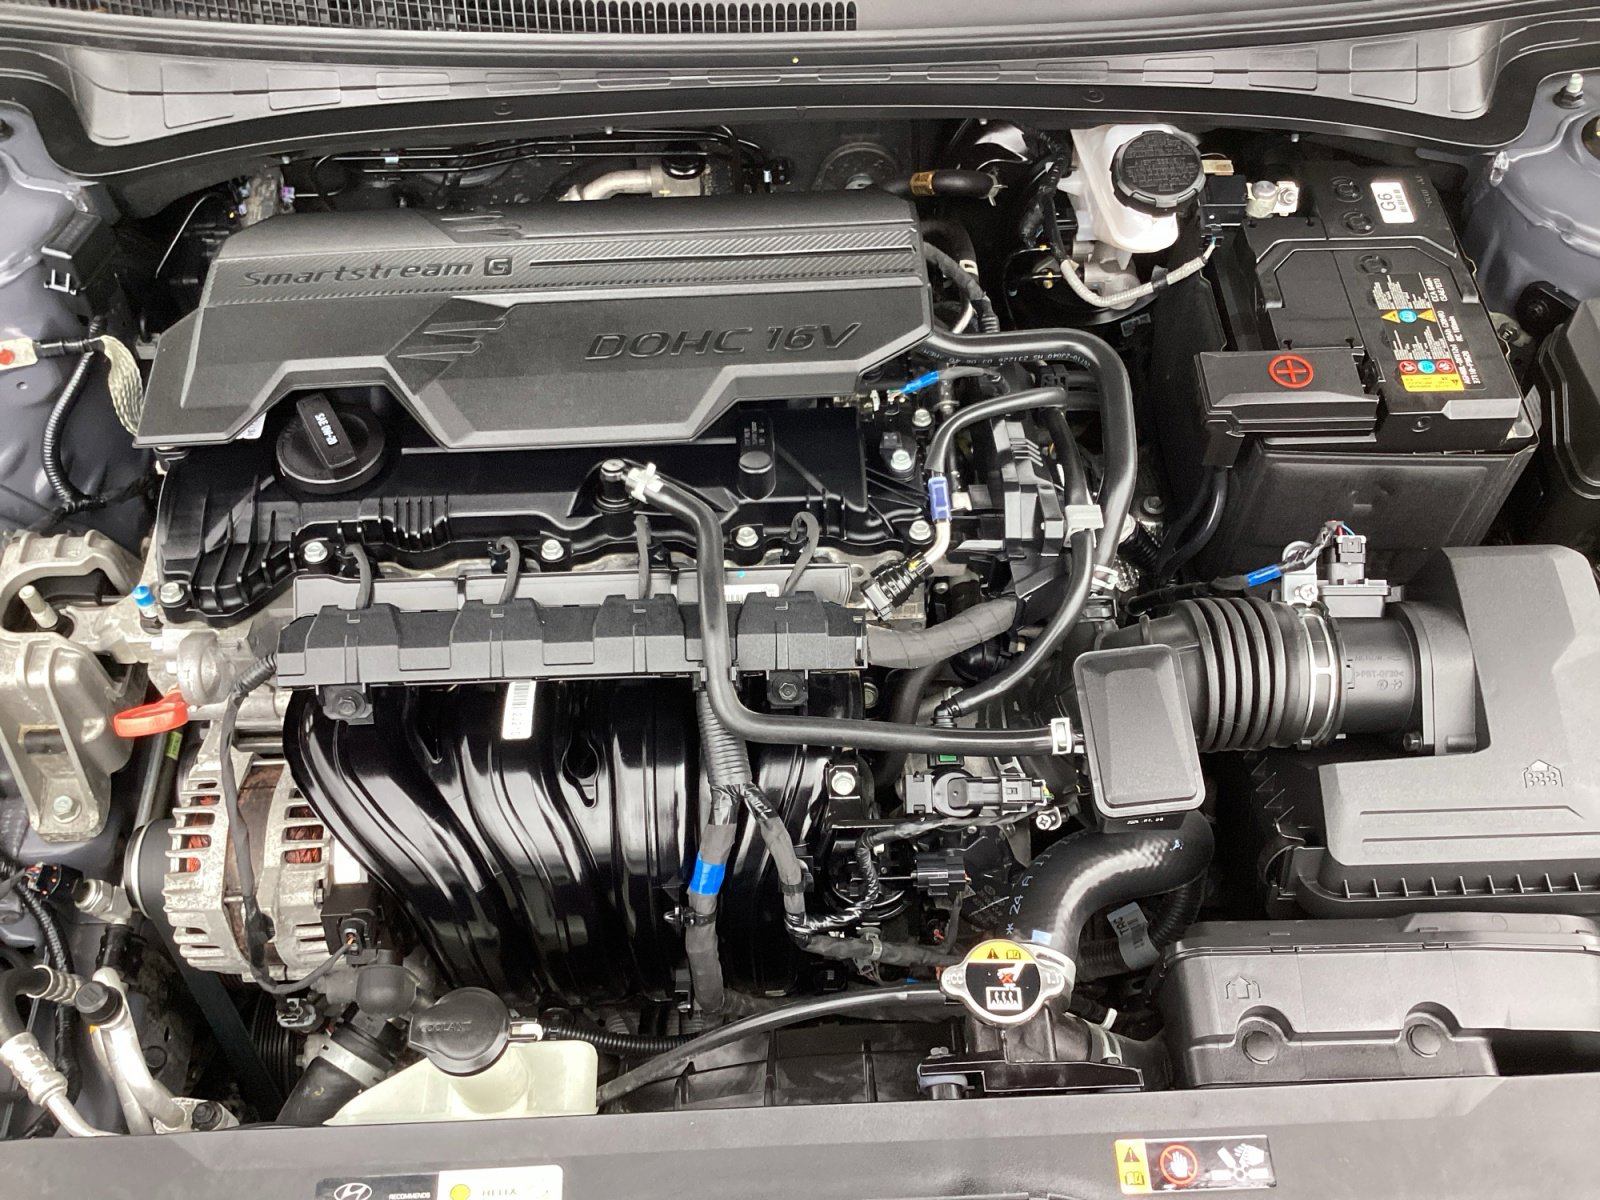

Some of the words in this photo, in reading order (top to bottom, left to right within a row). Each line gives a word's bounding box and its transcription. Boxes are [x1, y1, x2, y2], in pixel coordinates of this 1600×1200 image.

[1378, 193, 1397, 211] G6
[238, 263, 474, 287] Smartstream
[486, 257, 511, 276] G
[585, 327, 752, 360] DOHC
[766, 322, 862, 352] 16V
[314, 412, 329, 427] SAE
